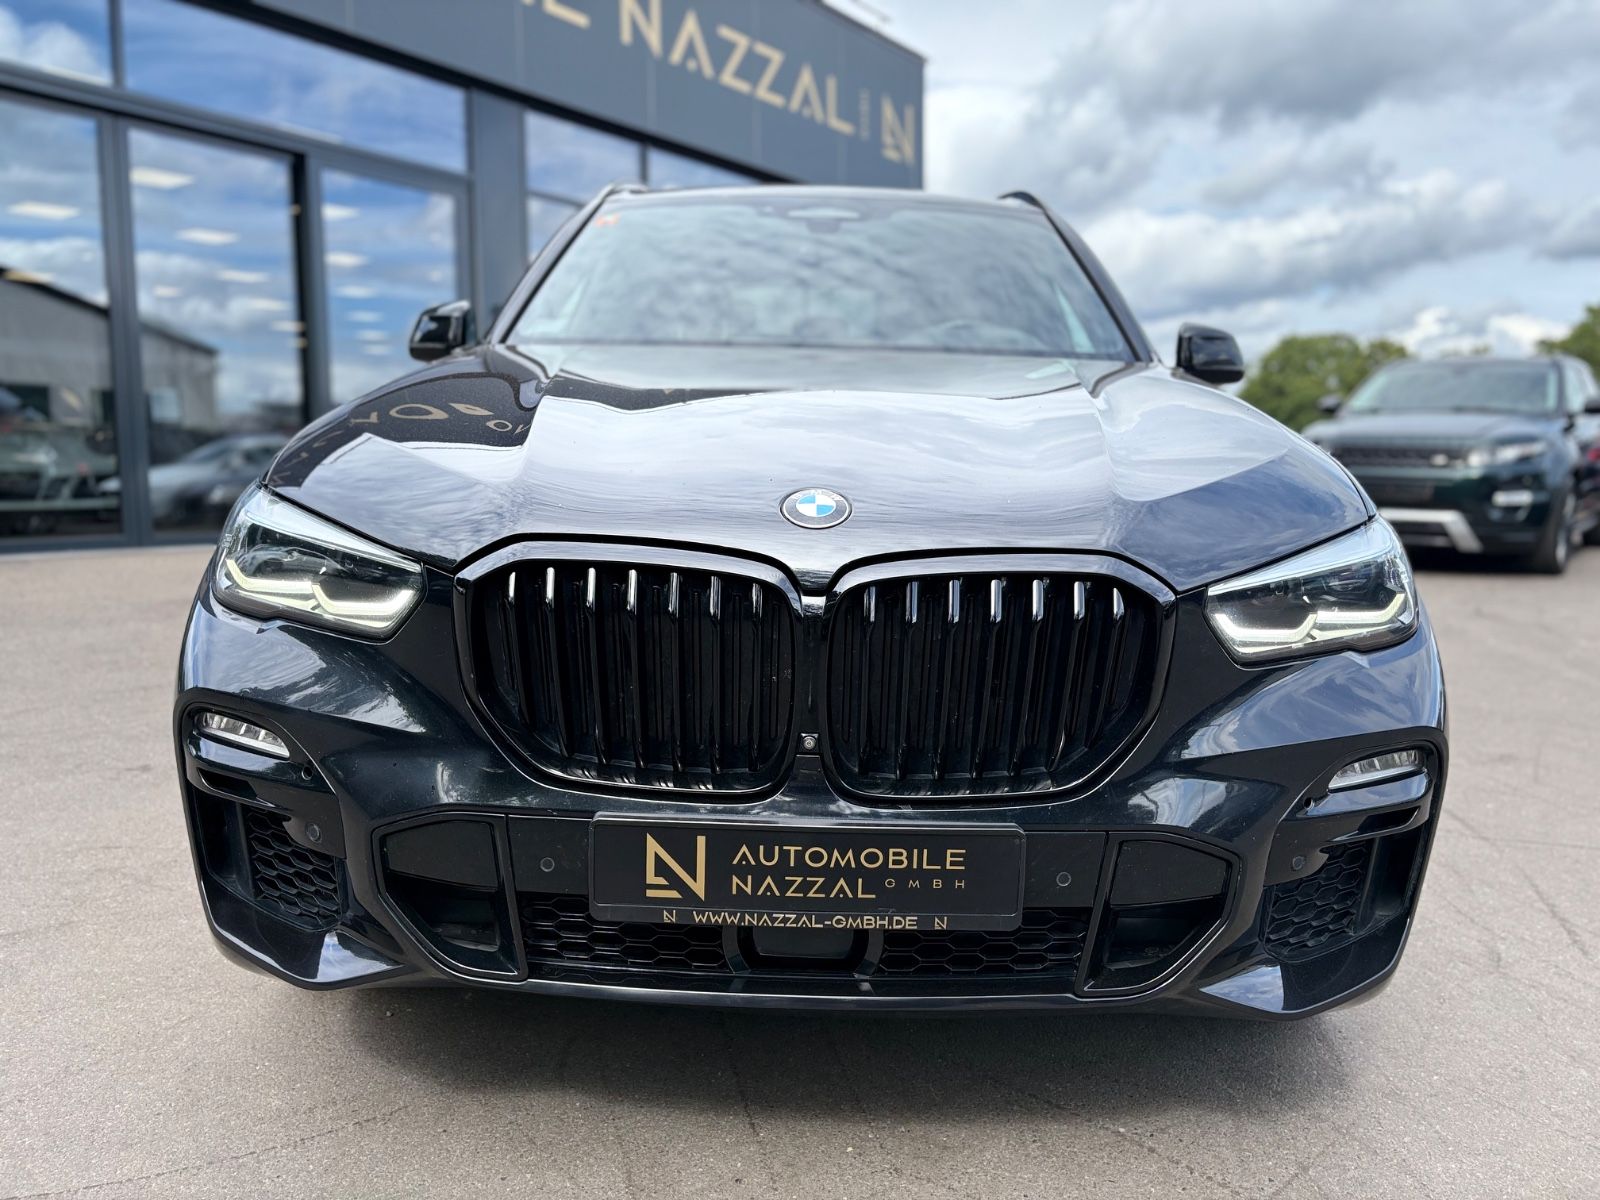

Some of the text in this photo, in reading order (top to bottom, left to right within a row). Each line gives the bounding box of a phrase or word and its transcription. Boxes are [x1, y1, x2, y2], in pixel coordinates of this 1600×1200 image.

[619, 0, 855, 136] NAZZAL
[732, 844, 967, 871] AUTOMOBILE
[731, 874, 966, 899] NAZZAL GMBH
[693, 910, 918, 930] WWW.NAZZAL-GMBH.DE
